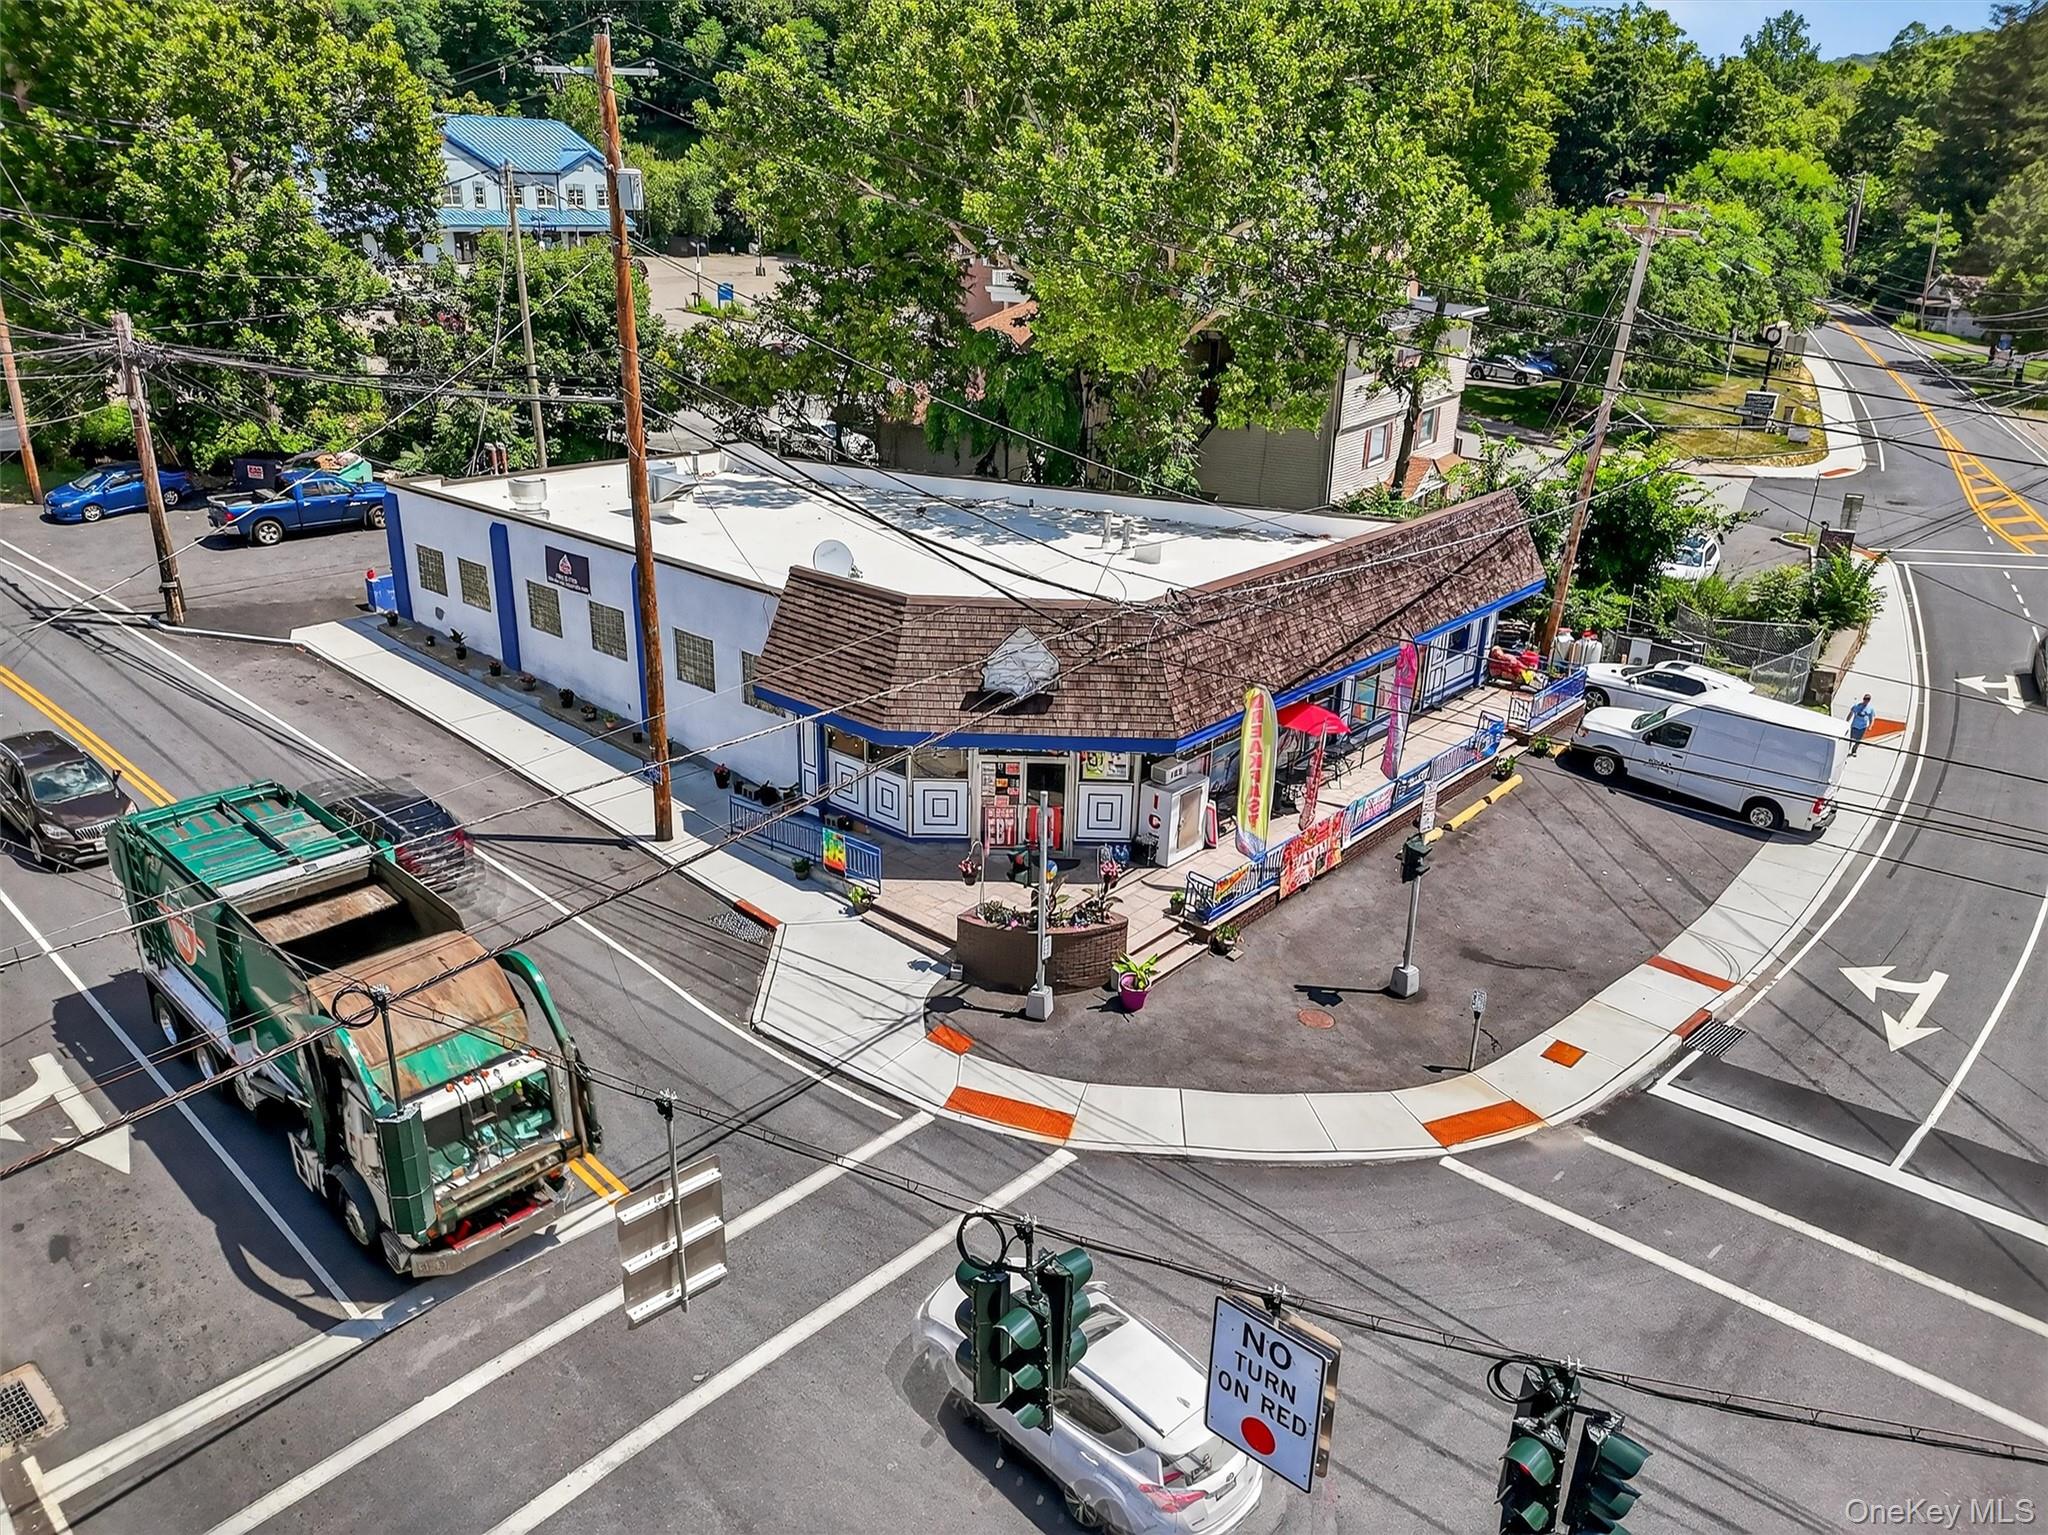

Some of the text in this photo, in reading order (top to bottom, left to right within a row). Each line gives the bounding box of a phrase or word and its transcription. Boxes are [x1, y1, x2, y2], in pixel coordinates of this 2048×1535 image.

[1242, 1321, 1293, 1371] NO
[1218, 1372, 1307, 1438] ON RED
[1235, 1351, 1297, 1405] TURN
